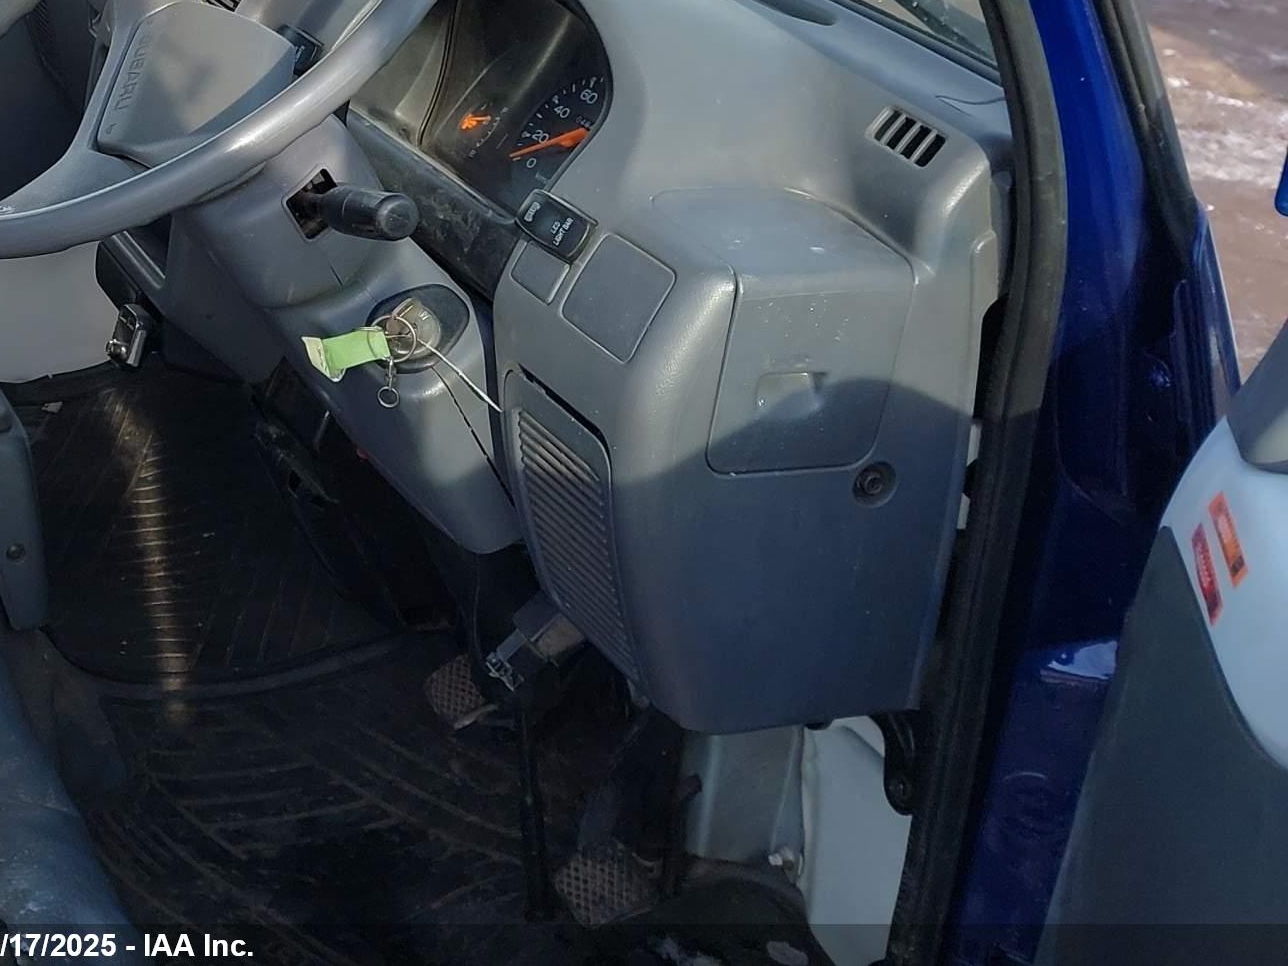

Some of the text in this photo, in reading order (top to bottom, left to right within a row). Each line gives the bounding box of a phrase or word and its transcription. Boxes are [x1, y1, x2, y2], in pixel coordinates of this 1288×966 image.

[115, 35, 152, 111] SUBARU
[580, 89, 598, 104] 60
[554, 106, 570, 119] 40
[531, 129, 549, 144] 20
[526, 157, 537, 169] 0
[550, 221, 561, 235] LED
[552, 217, 574, 246] LIGHT BAR
